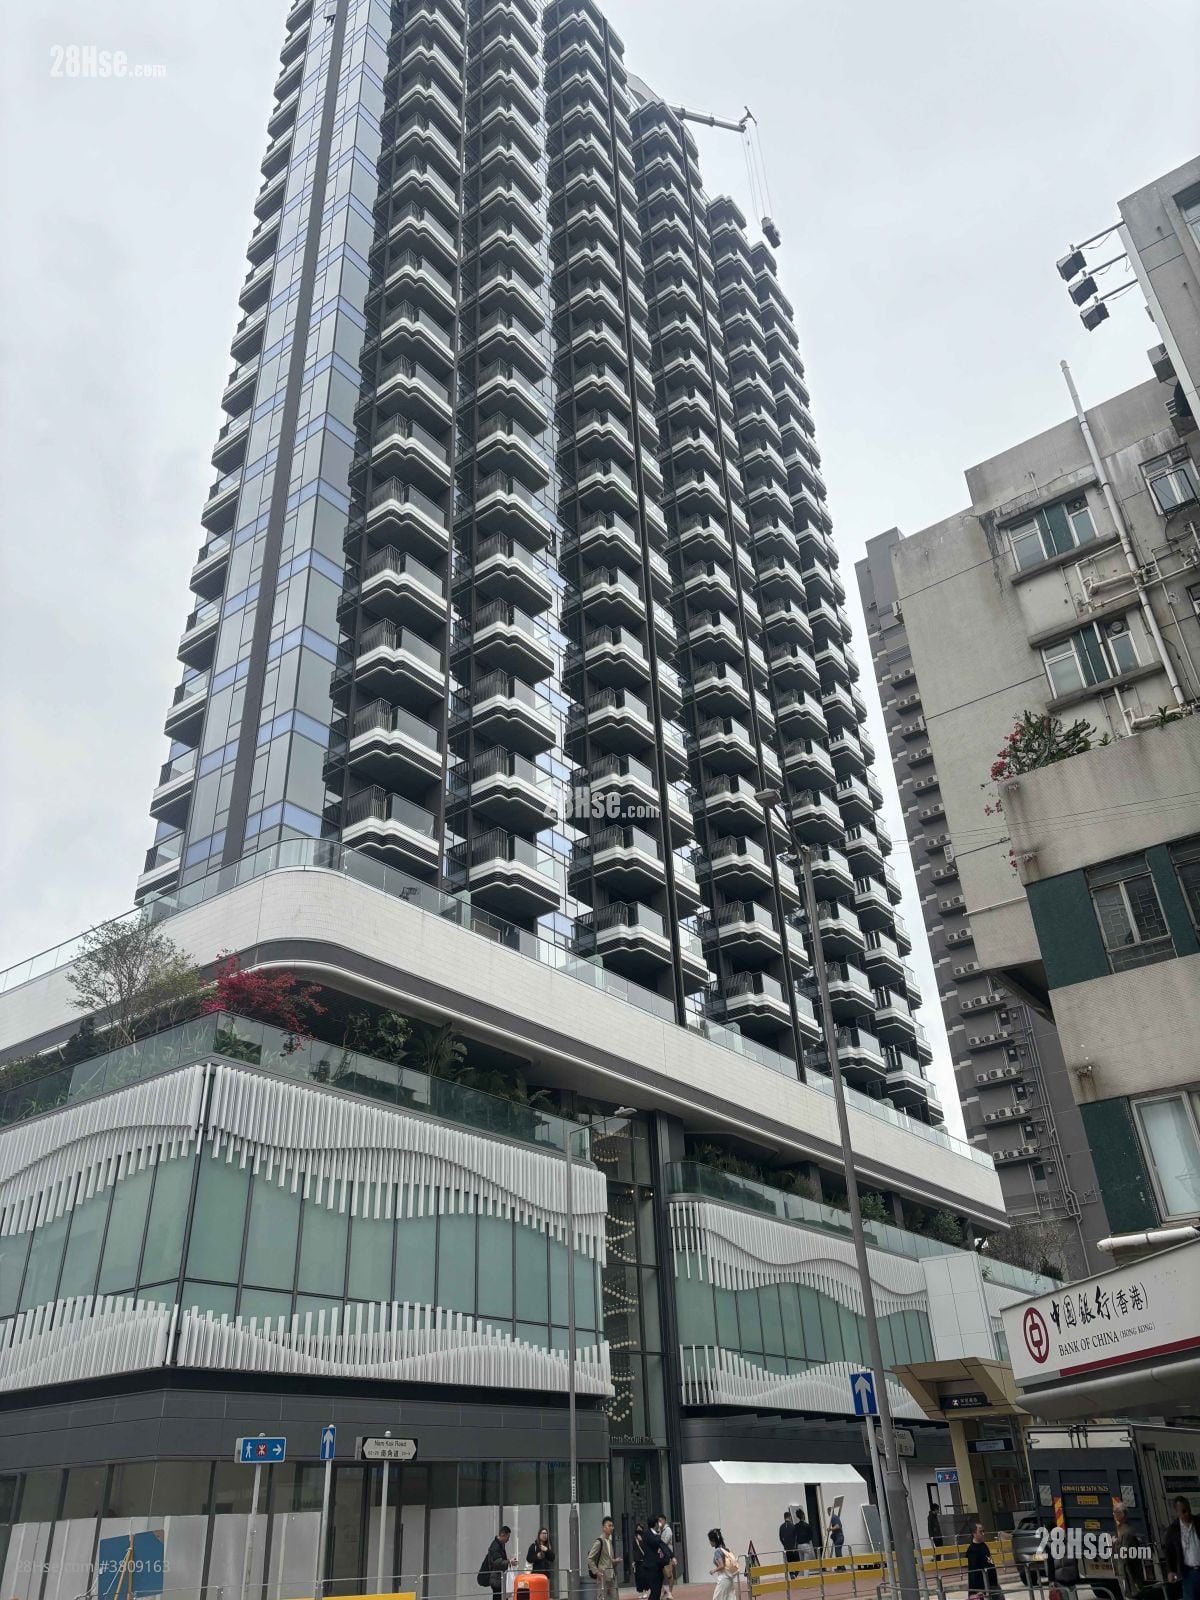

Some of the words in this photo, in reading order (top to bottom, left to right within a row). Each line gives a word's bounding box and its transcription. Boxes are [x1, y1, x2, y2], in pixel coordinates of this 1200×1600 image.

[1058, 1340, 1080, 1357] BANK
[1080, 1336, 1092, 1351] OF
[1091, 1330, 1120, 1348] CHINA
[1158, 1450, 1179, 1470] MING
